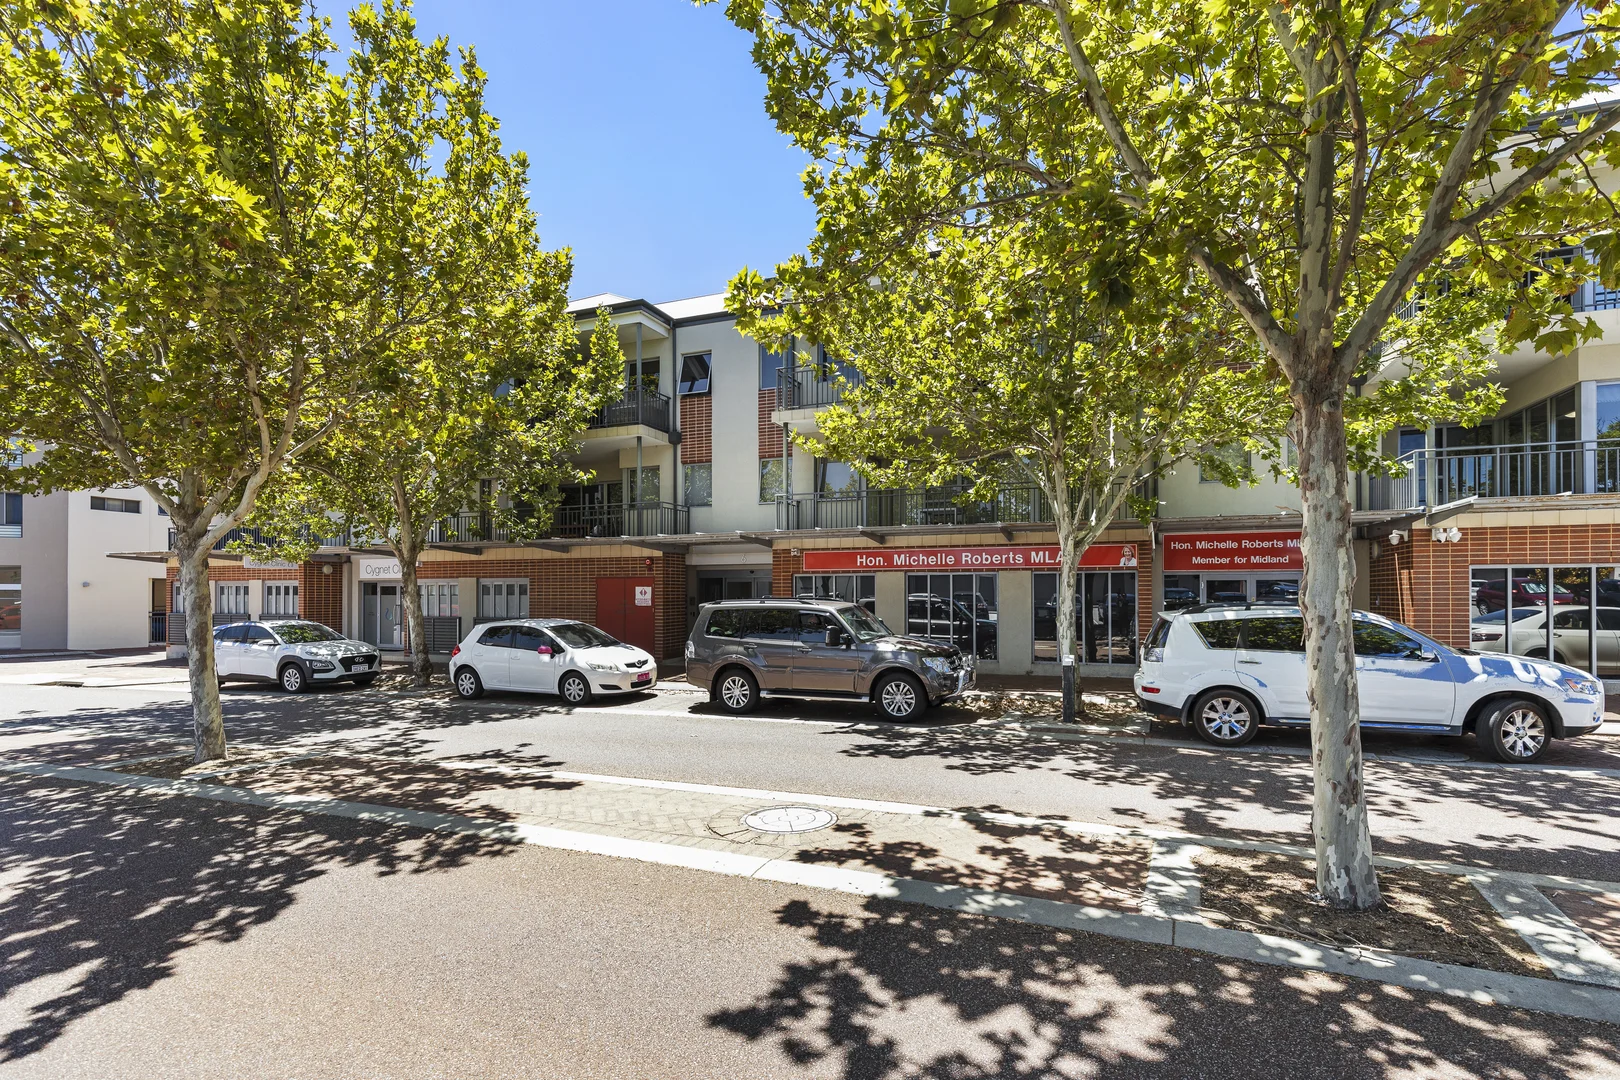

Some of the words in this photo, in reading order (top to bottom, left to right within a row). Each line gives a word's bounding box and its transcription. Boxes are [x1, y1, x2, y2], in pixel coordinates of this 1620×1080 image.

[1170, 541, 1193, 550] Hon.
[1195, 540, 1239, 550] Michelle
[1241, 539, 1284, 549] Roberts
[856, 554, 888, 567] Hon.
[893, 553, 955, 566] Michelle
[961, 551, 1024, 565] Roberts
[1191, 556, 1231, 565] Member
[1234, 555, 1248, 564] for
[1250, 555, 1290, 564] Midland
[365, 564, 391, 577] Cygnet
